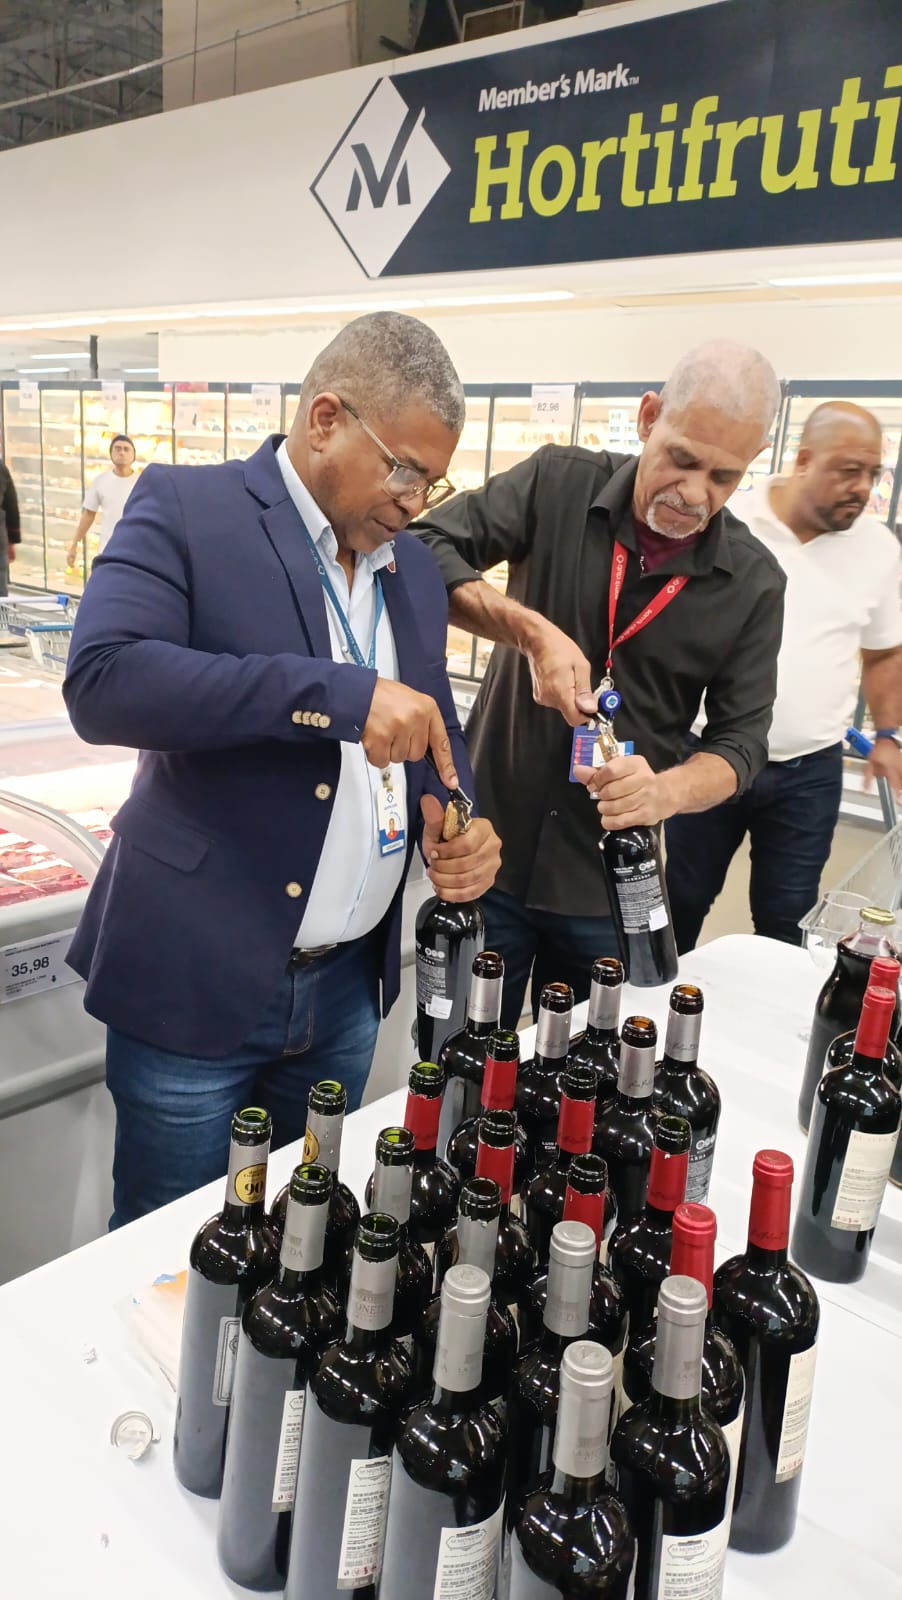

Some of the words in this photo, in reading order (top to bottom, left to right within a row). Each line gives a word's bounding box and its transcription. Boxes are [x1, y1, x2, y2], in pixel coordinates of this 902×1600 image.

[478, 74, 571, 112] Member's
[469, 65, 902, 223] Hortifruti
[11, 956, 50, 977] 35,98
